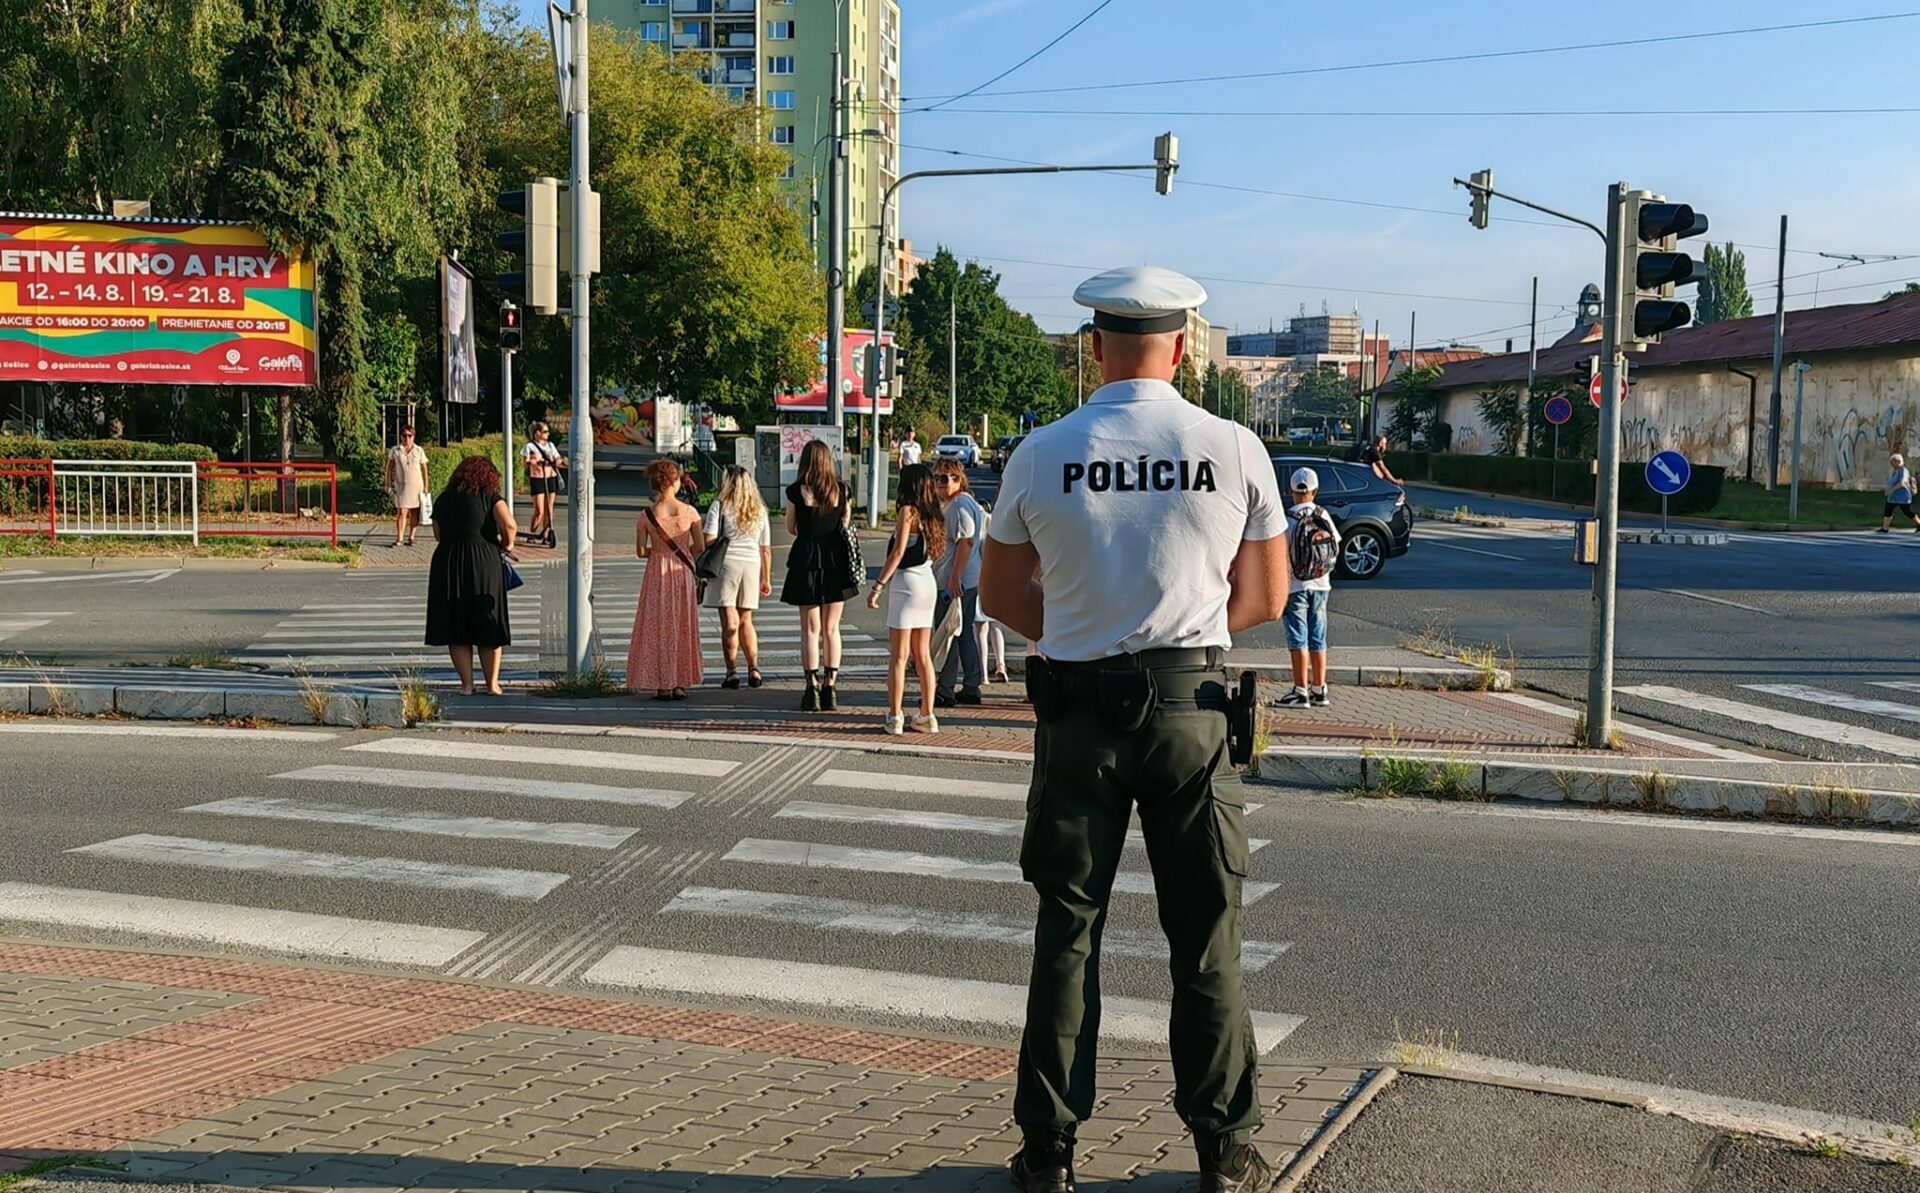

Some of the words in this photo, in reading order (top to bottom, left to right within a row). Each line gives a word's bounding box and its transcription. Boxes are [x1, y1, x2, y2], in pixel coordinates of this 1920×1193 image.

[0, 245, 86, 273] ETNÉ
[94, 251, 175, 276] KINO
[183, 254, 207, 277] A
[215, 255, 278, 279] HRY
[26, 283, 55, 300] 12.
[142, 285, 169, 302] 19.
[0, 316, 33, 326] AKCIE
[35, 317, 54, 326] OD
[56, 317, 89, 327] 16:00
[91, 318, 108, 327] DO
[111, 318, 146, 328] 20:00
[162, 318, 234, 329] PREMIETANIE
[236, 320, 254, 330] OD
[256, 321, 286, 331] 20:15
[1063, 454, 1217, 494] POLÍCIA
